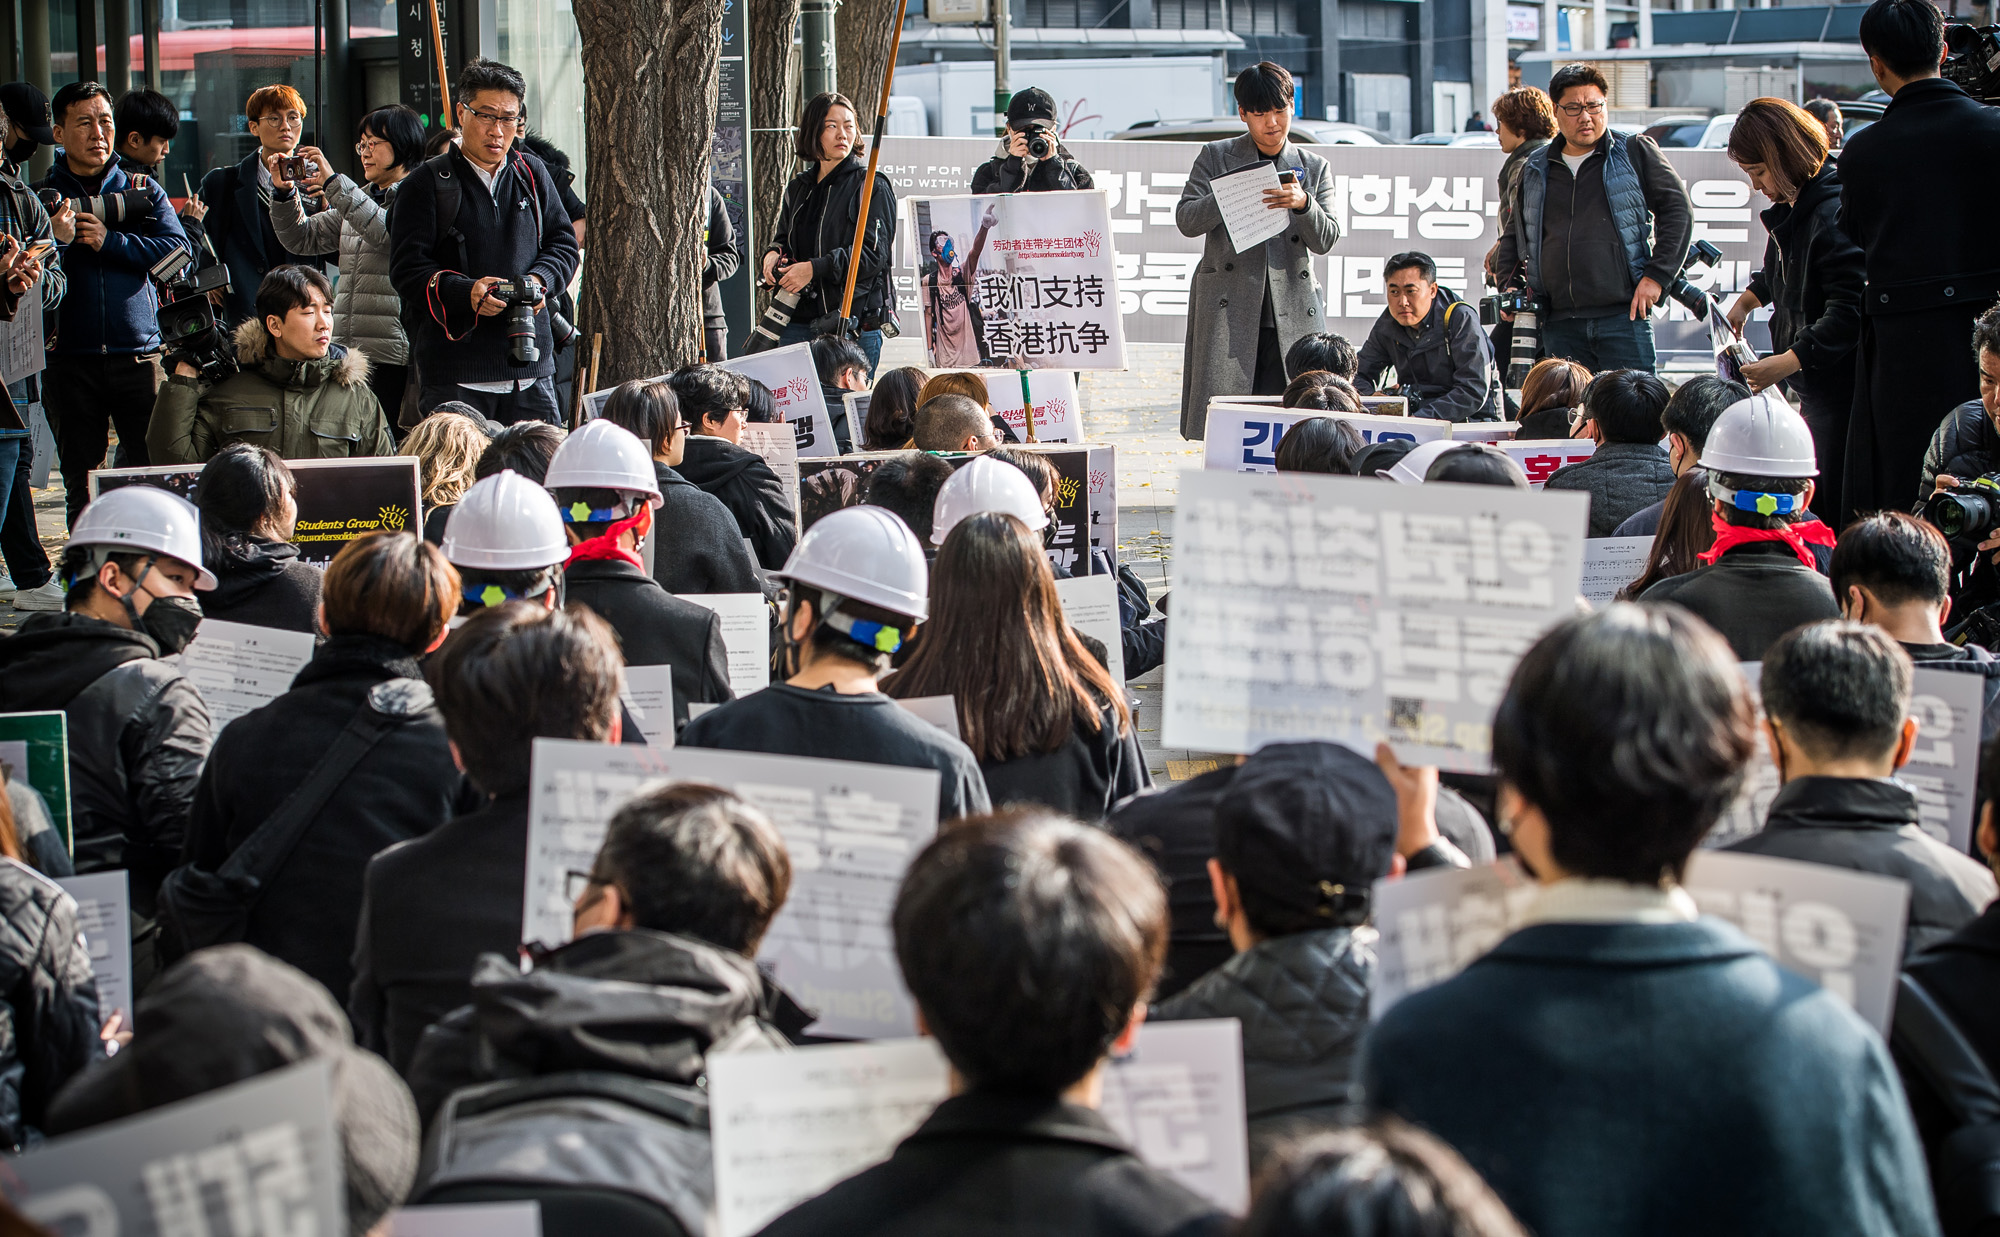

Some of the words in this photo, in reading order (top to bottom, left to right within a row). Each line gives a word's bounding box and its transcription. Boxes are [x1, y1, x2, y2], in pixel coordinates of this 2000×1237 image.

[409, 2, 423, 58] 시청
[1027, 103, 1036, 112] W
[927, 166, 962, 176] FOR
[919, 178, 959, 189] WITH
[992, 238, 1085, 251] 劳动者连带学生团体
[979, 273, 1106, 310] 我们支持
[984, 320, 1111, 355] 香港抗争
[1002, 406, 1046, 421] 학생룹
[295, 520, 344, 531] Students
[346, 518, 380, 530] Group
